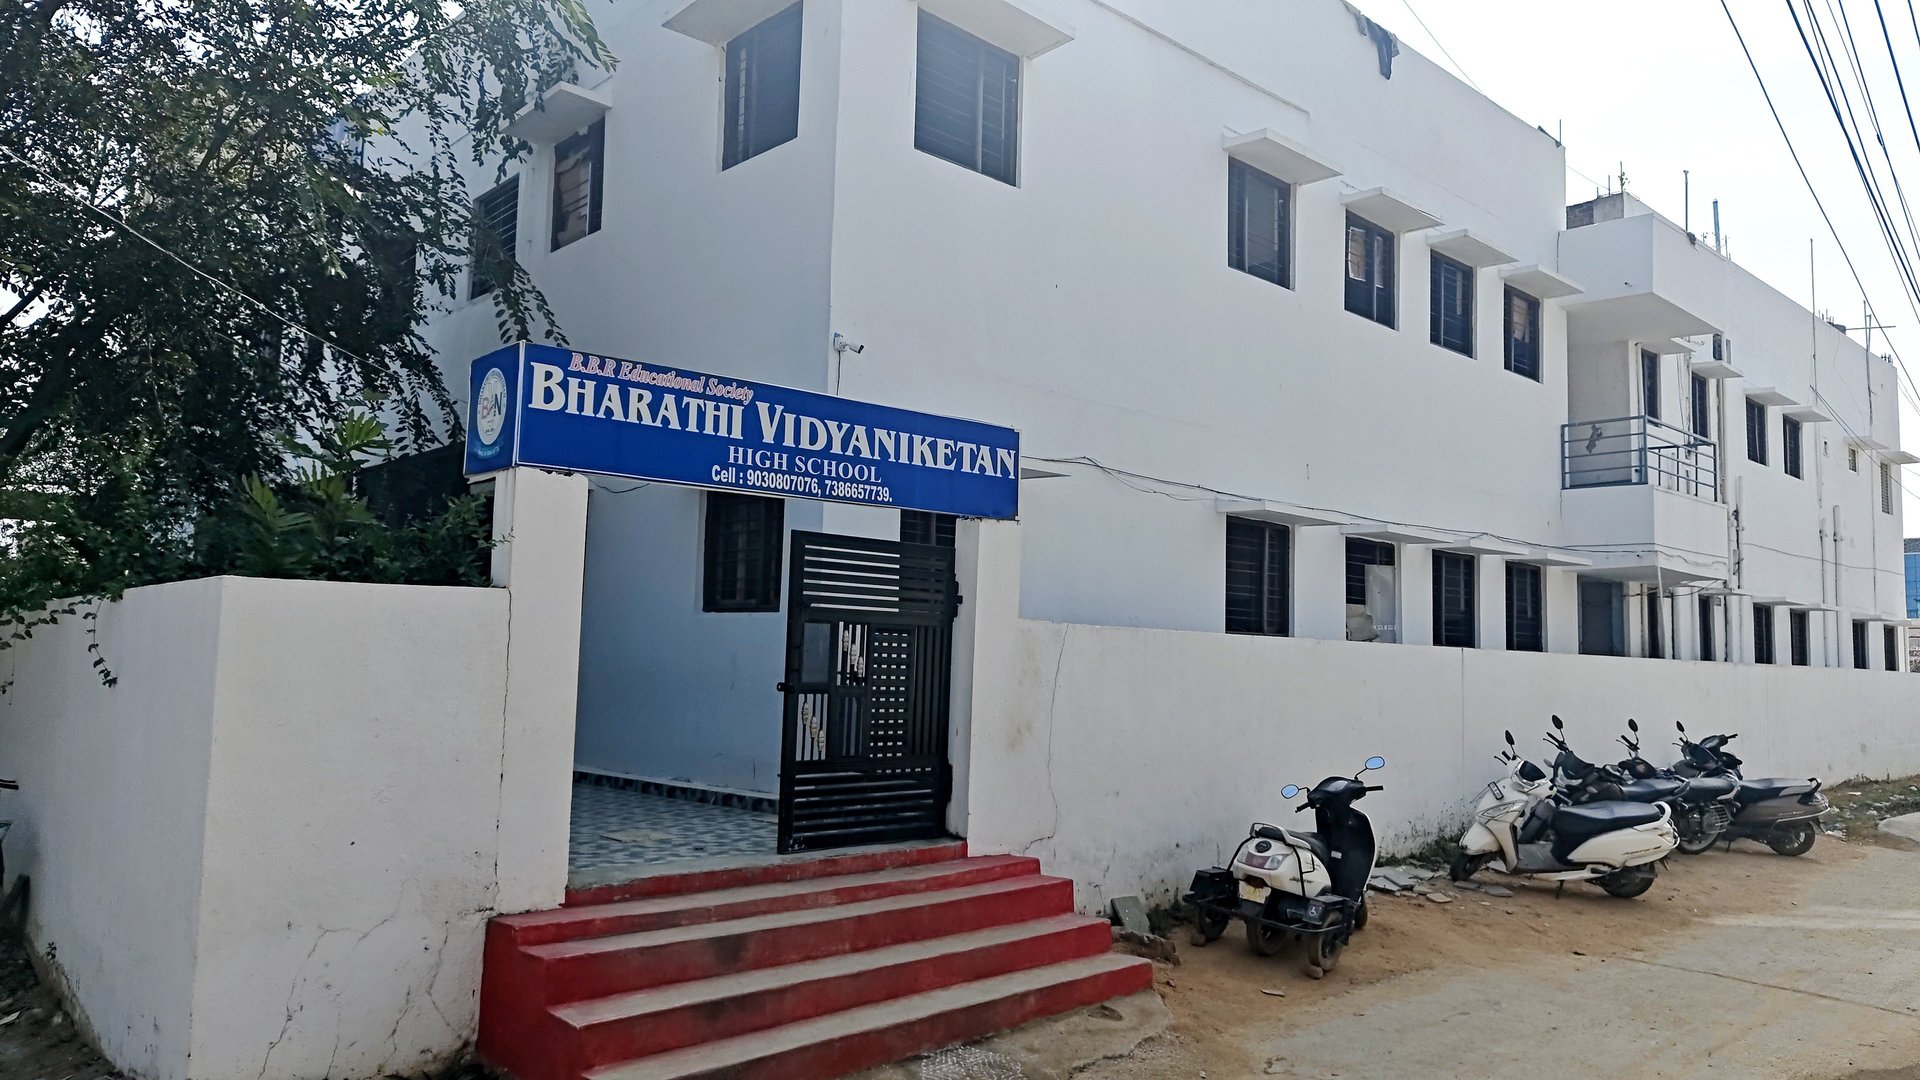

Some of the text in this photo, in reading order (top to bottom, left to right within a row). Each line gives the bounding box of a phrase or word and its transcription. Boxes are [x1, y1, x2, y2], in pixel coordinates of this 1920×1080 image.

[568, 352, 754, 405] B.B.R Educational Society
[528, 361, 744, 440] BHARATHI
[756, 401, 1016, 480] VIDYANIKETAN
[711, 464, 736, 483] Cell
[747, 469, 822, 497] 9030807076,
[825, 480, 893, 502] 7386657739.
[728, 445, 882, 483] HIGH SCHOOL
